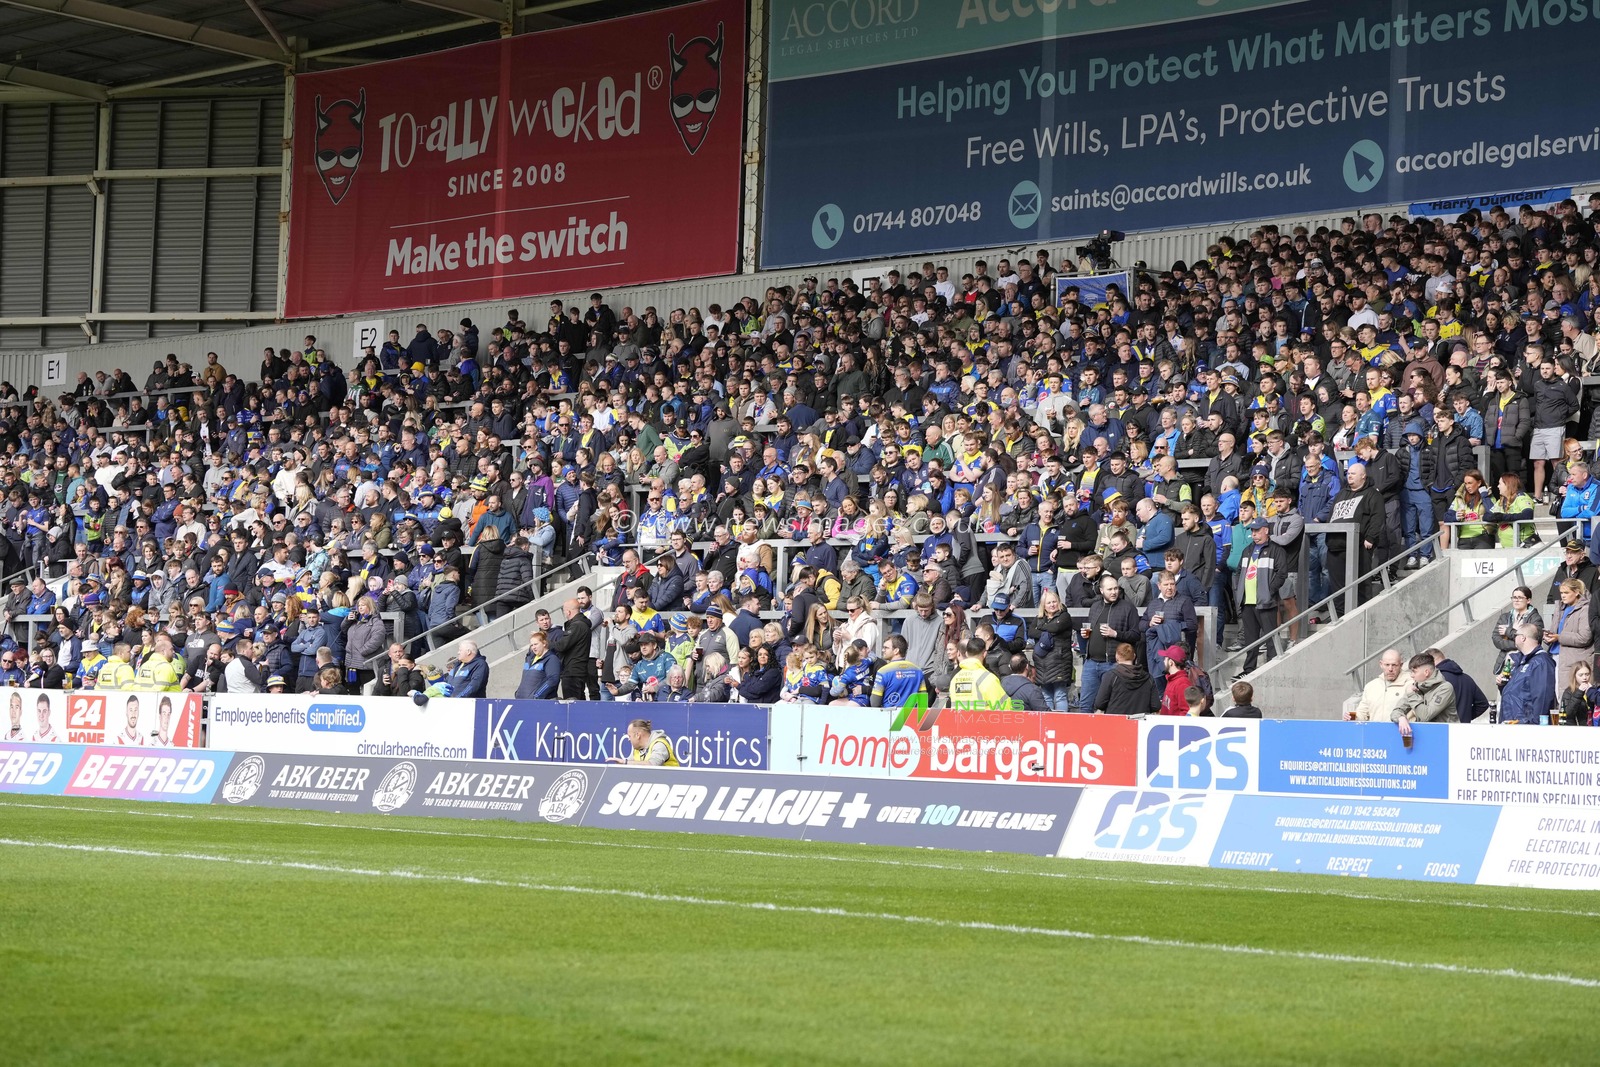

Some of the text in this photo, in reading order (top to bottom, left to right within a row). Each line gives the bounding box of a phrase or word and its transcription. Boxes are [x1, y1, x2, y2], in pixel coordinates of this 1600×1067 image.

[781, 0, 920, 41] ACCORD
[956, 0, 1116, 28] Acc
[781, 26, 919, 57] LEGAL SERVICES LTD
[897, 76, 1011, 122] Helping
[1019, 66, 1077, 99] You
[1088, 45, 1218, 92] Protect
[1227, 27, 1324, 73] What
[1334, 8, 1492, 57] Matters
[966, 136, 1025, 168] Free
[1033, 121, 1109, 160] Wills,
[1219, 86, 1389, 138] Protective
[1398, 70, 1506, 113] Trusts
[447, 162, 566, 198] SINCE 2008
[1051, 163, 1311, 213] saints@accordwills.co.uk
[853, 201, 982, 234] 01744 807048
[385, 211, 628, 276] Make the switch
[360, 328, 377, 349] E2
[47, 358, 61, 380] E1
[1475, 562, 1494, 575] VE4
[70, 698, 102, 726] 24
[186, 700, 196, 747] AINTS
[215, 707, 262, 726] Employee
[264, 708, 305, 724] benefits
[357, 739, 467, 758] circularbenefits.com
[673, 729, 762, 767] gistics
[818, 723, 1104, 782] home bargains
[1146, 724, 1249, 791] CBS
[1318, 748, 1387, 759] +44 (0) 1942 583424
[1470, 747, 1600, 764] CRITICAL INFRASTRUCTURE
[72, 753, 215, 794] BETFRED
[271, 764, 370, 791] ABK BEER
[425, 771, 479, 796] ABK
[474, 773, 535, 799] BEER
[1466, 768, 1522, 783] ELECTRICAL
[1525, 770, 1592, 786] INSTALLATION
[231, 787, 249, 797] ABK
[268, 790, 278, 798] 700
[279, 790, 295, 799] YEARS
[303, 791, 327, 800] BAVARIAN
[327, 793, 359, 802] PERFECTION
[380, 795, 401, 804] ABK
[422, 798, 433, 806] 700
[434, 799, 451, 807] YEARS
[460, 800, 487, 809] BAVARIAN
[487, 802, 523, 811] PERFECTION
[599, 781, 708, 820] SUPER
[1457, 789, 1478, 801] FIRE
[1481, 790, 1539, 803] PROTECTION
[547, 803, 570, 815] ABK
[876, 804, 1056, 832] OVER 100 LIVE GAMES
[1094, 791, 1207, 852] CBS
[1324, 805, 1401, 818] +44 (0) 1942 583424
[1537, 818, 1586, 833] CRITICAL
[1085, 851, 1111, 860] CRITICAL
[1113, 852, 1140, 861] BUSINESS
[1142, 854, 1173, 863] SOLUTIONS
[1526, 838, 1590, 855] ELECTRICAL
[1220, 850, 1461, 878] INTEGRITY RESPECT FOCUS
[1508, 859, 1600, 878] FIRE PROTECTIO
